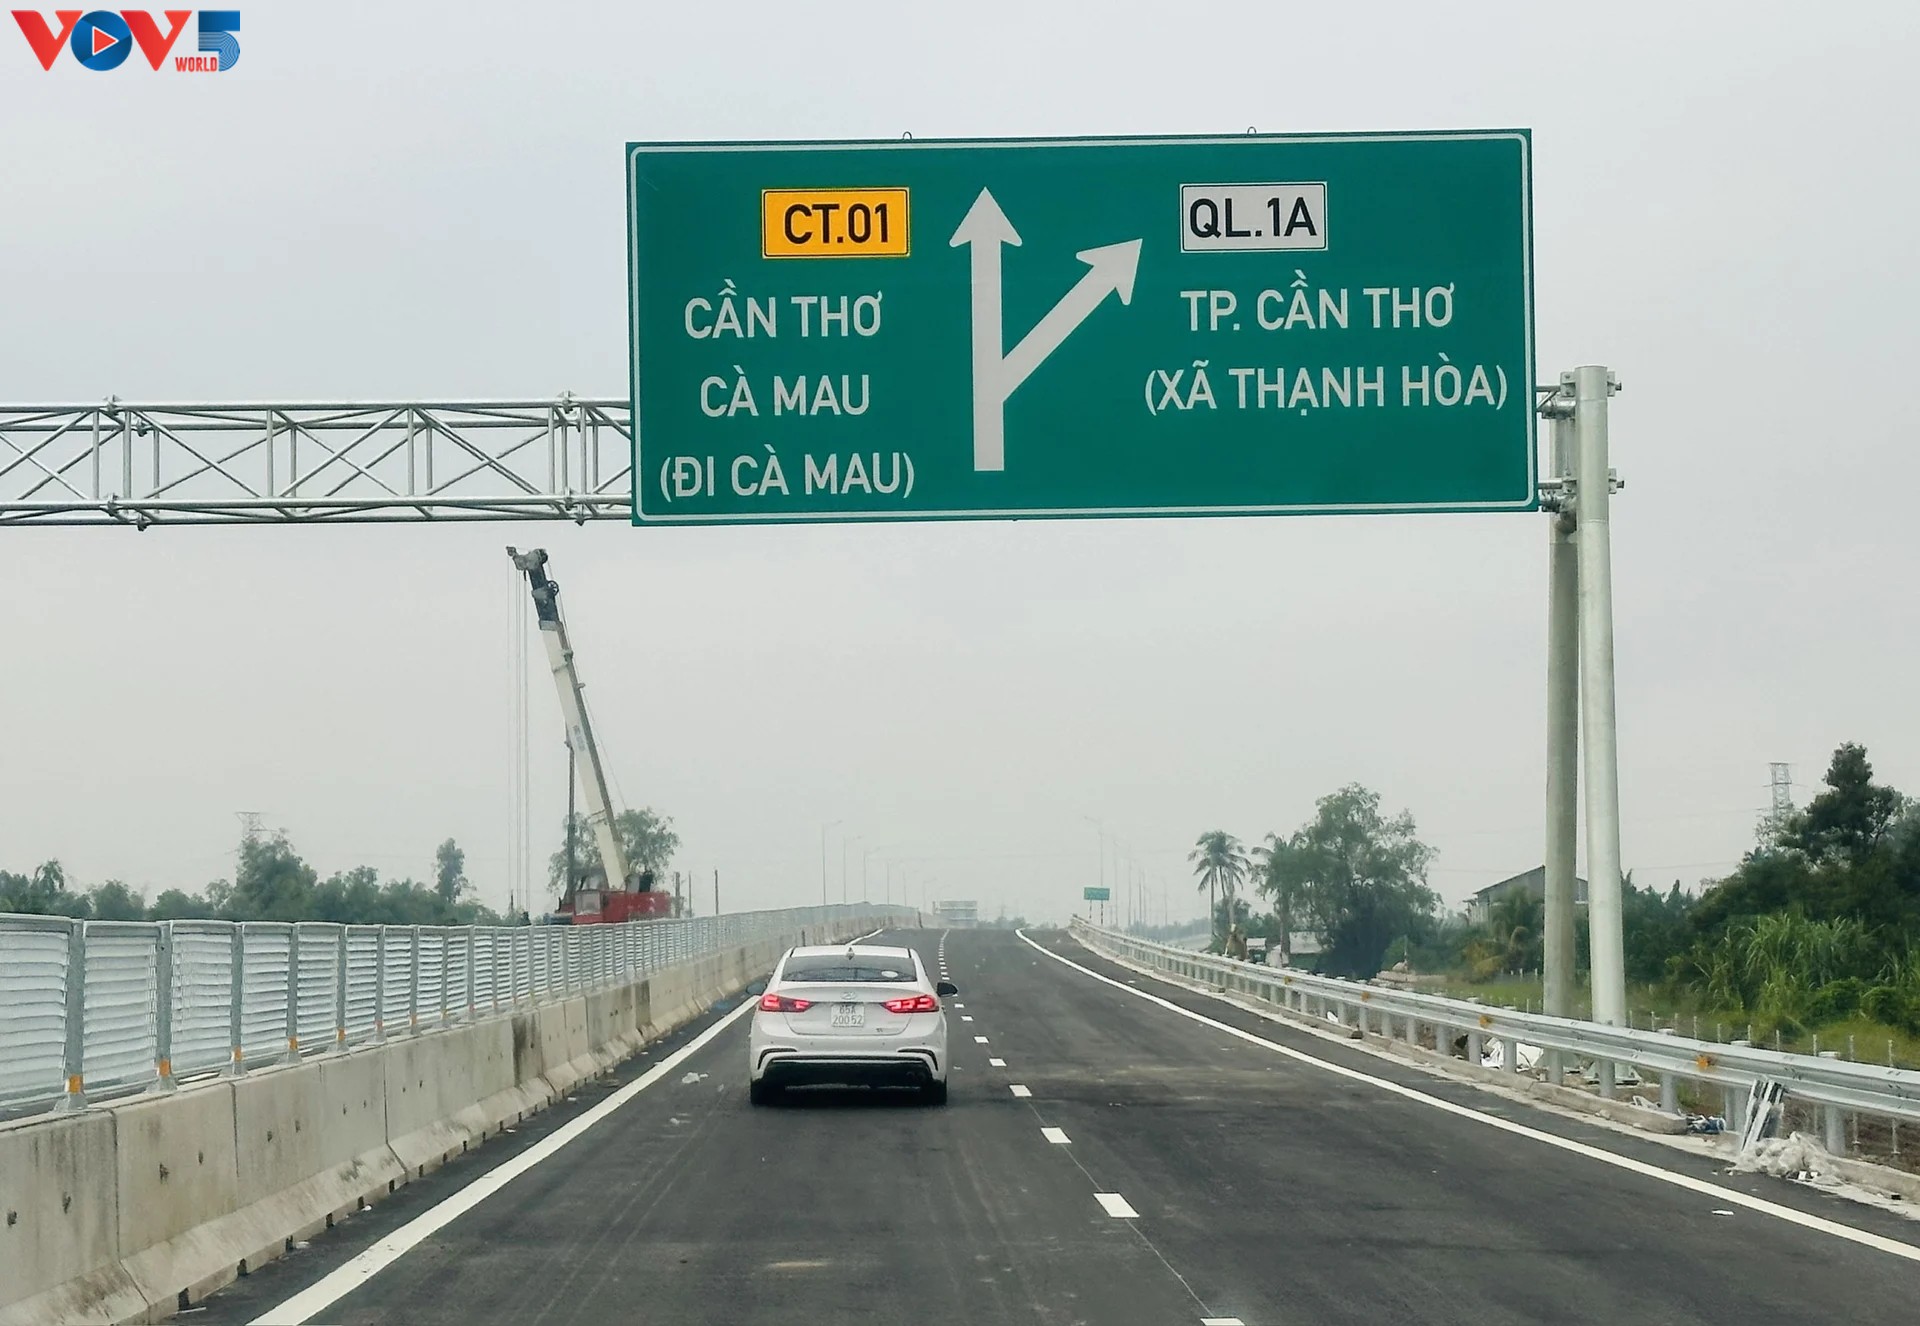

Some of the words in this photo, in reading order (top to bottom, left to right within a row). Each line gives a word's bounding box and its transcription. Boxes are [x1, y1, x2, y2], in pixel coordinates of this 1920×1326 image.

[784, 203, 888, 244] CT.01
[1189, 197, 1317, 238] QL.1A
[685, 279, 776, 338] CẦN
[791, 291, 882, 337] THƠ
[1181, 291, 1239, 331] TP.
[1258, 270, 1348, 330] CẦN
[1363, 283, 1454, 328] THƠ
[701, 365, 758, 417] CÀ
[774, 375, 869, 416] MAU
[1146, 360, 1217, 415] (XÃ
[1229, 367, 1384, 415] THẠNH
[1402, 353, 1507, 409] HÒA)
[661, 457, 714, 502] (ĐI
[732, 444, 789, 496] CÀ
[805, 453, 914, 498] MAU)
